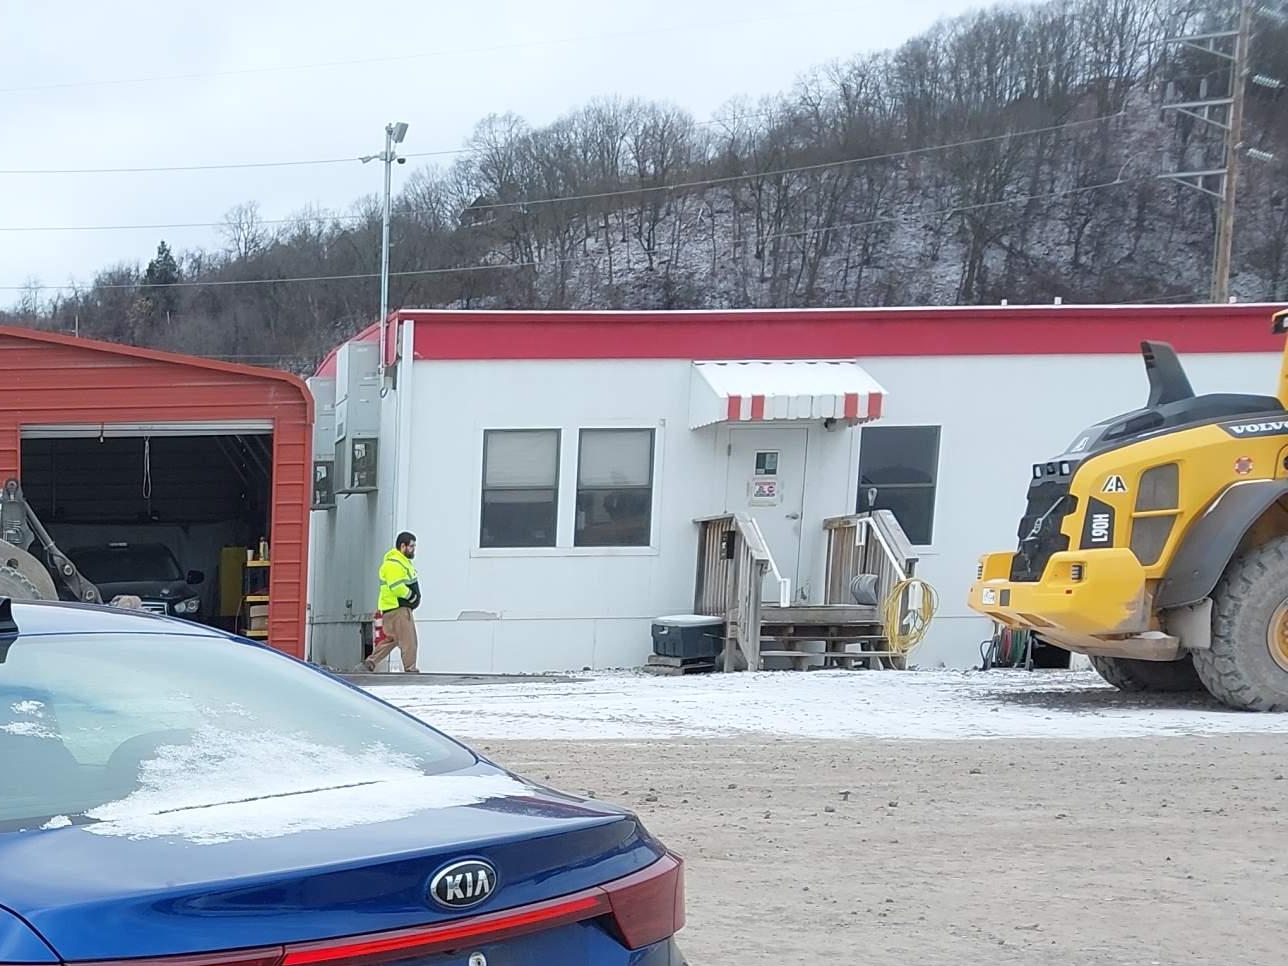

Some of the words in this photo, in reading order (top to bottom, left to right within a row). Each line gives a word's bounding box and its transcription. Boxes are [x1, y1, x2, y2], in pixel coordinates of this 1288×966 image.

[1229, 421, 1288, 433] VOLV
[1092, 513, 1109, 542] L90H
[445, 869, 489, 900] KIA
